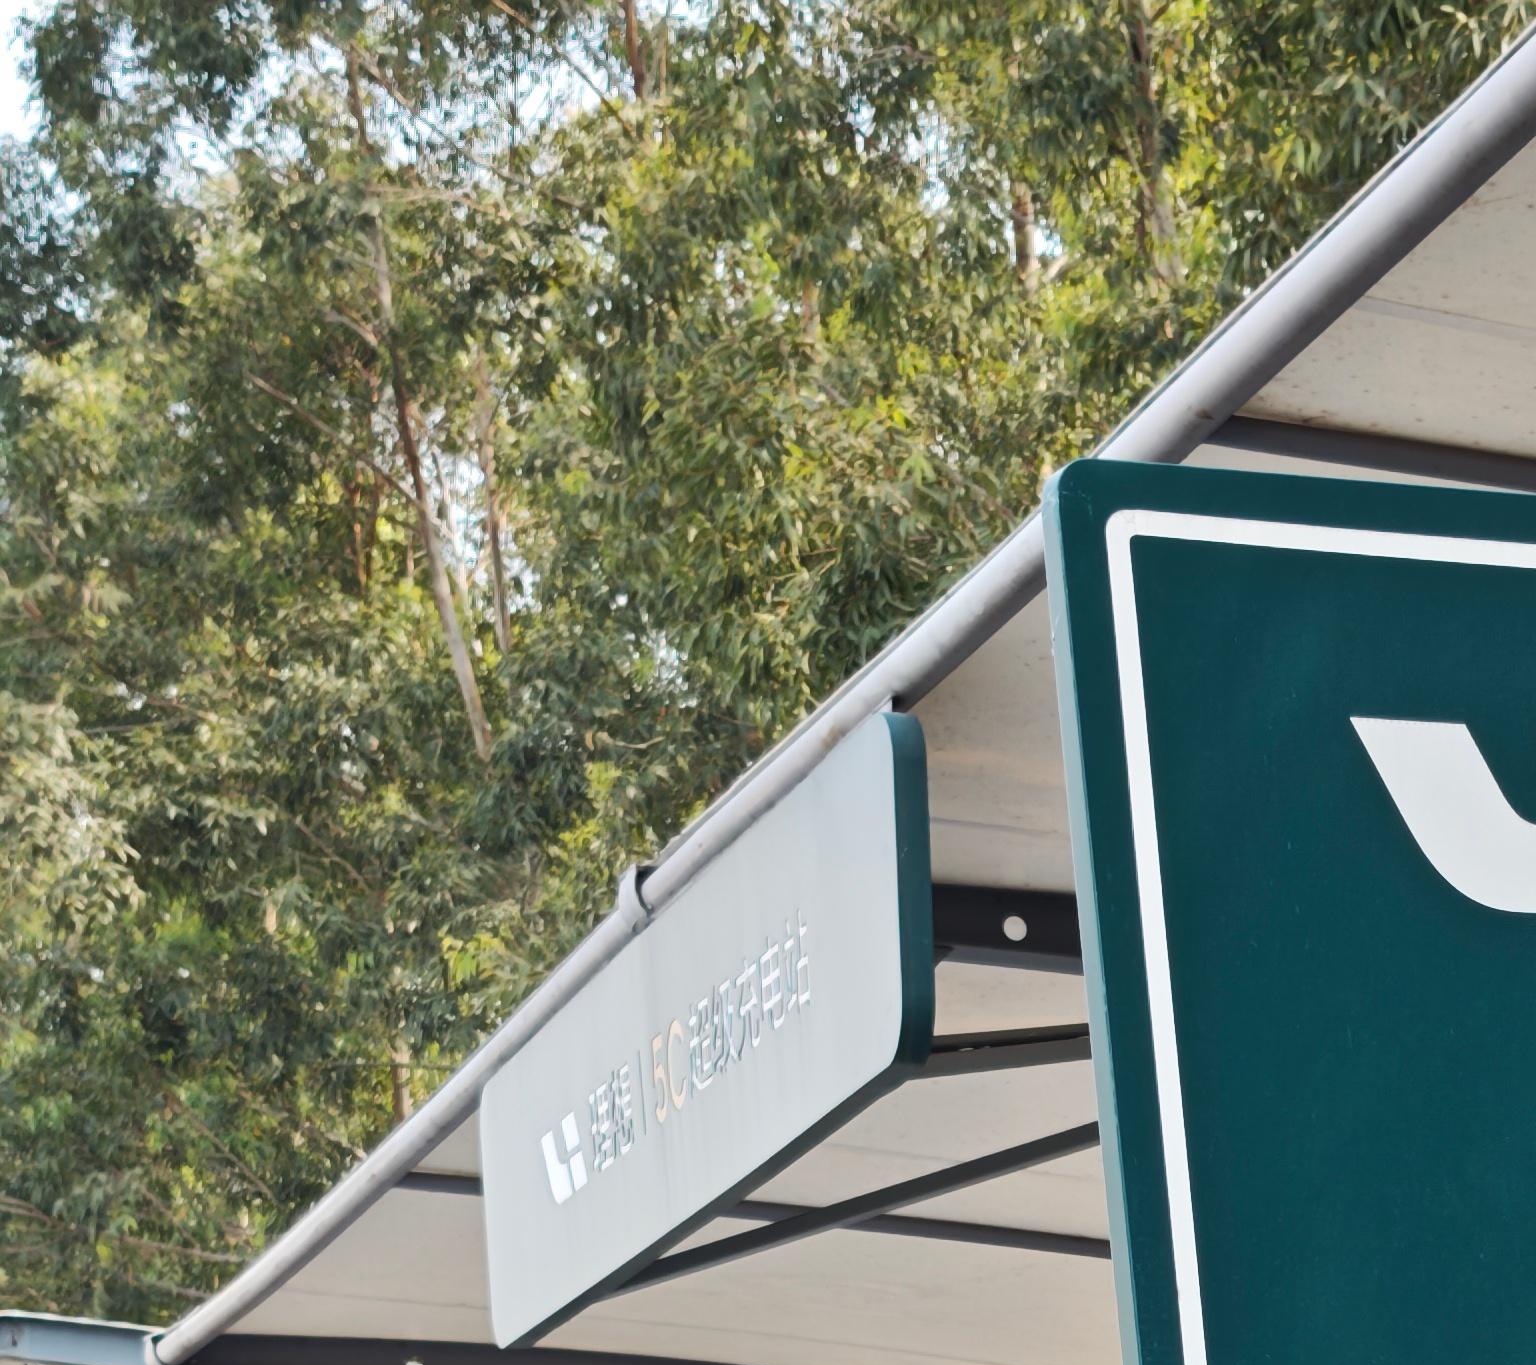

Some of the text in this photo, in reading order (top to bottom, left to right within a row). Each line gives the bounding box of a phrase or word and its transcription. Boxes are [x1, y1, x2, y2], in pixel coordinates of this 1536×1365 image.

[588, 907, 813, 1172] 理想 5C超级充电站
